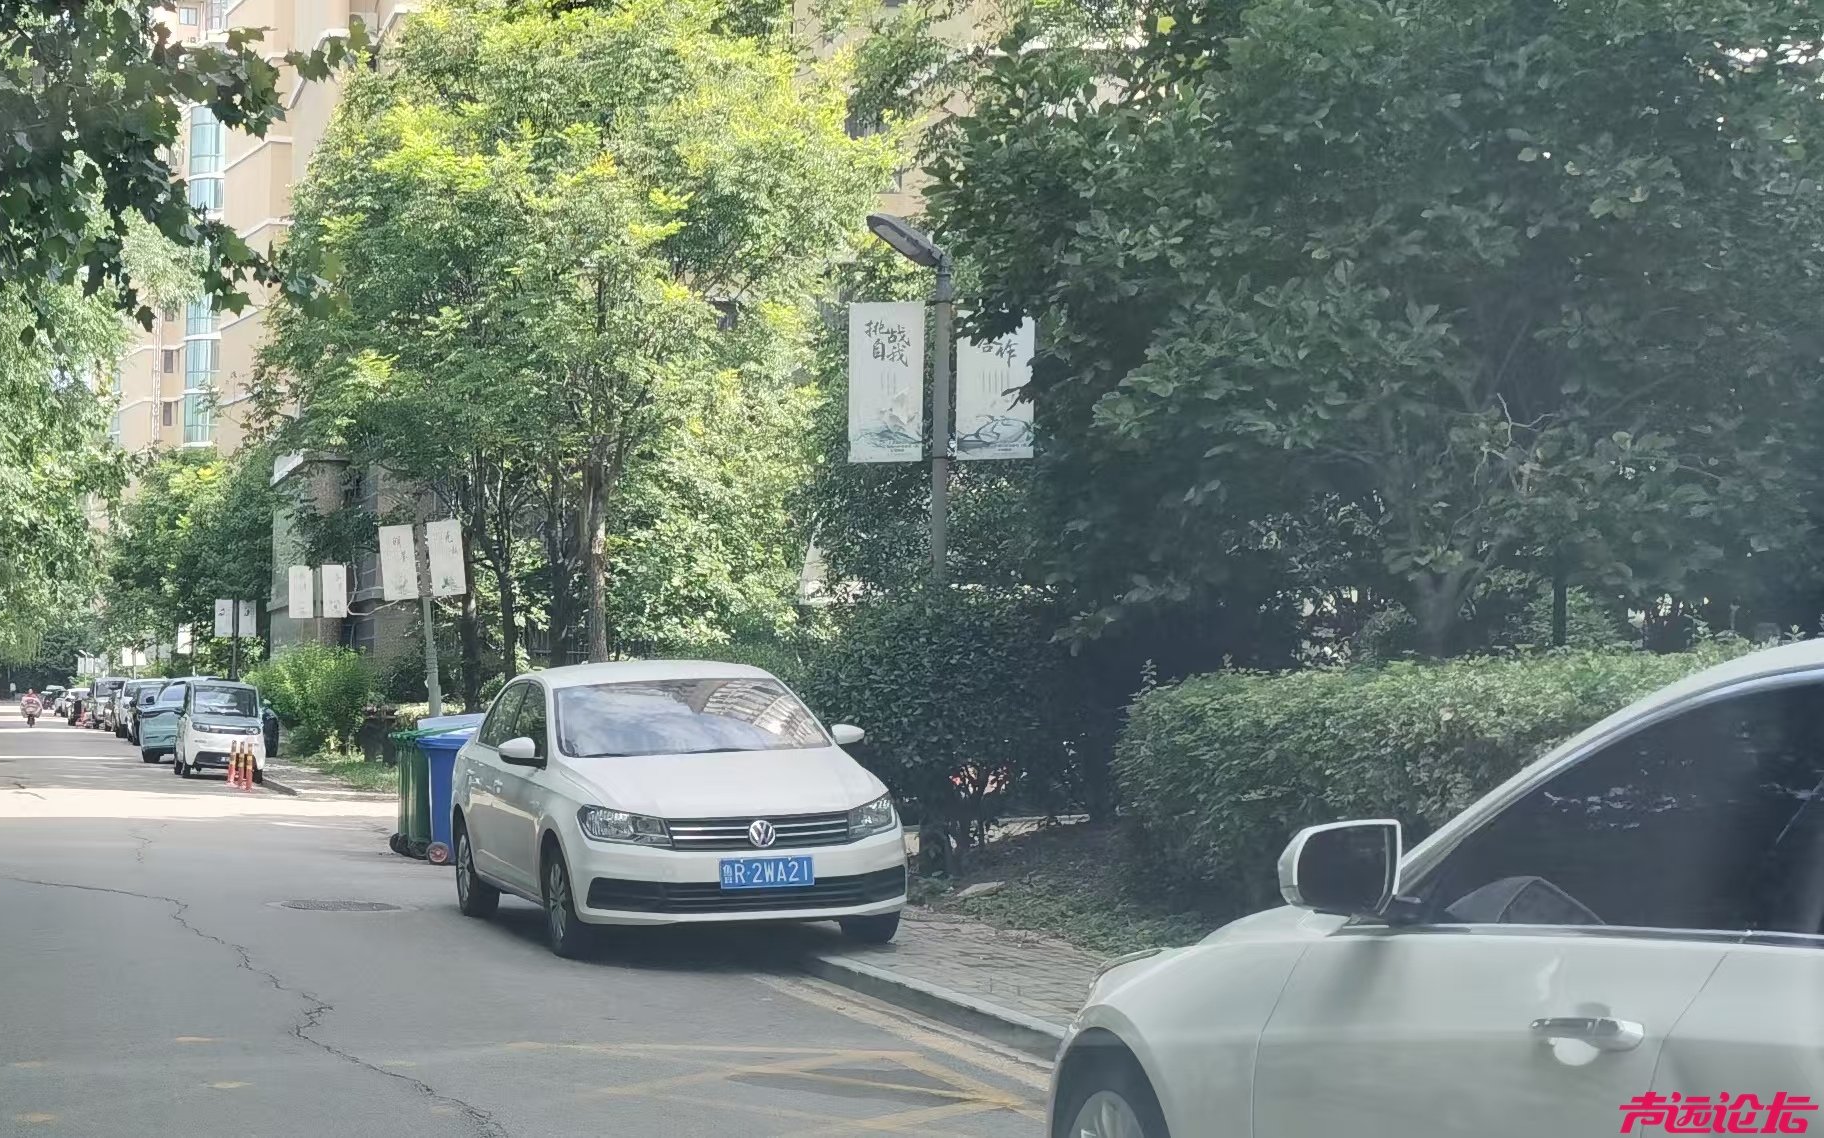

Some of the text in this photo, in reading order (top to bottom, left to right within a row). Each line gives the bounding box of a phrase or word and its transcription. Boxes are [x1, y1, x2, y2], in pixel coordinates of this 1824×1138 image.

[864, 320, 911, 347] 挑战
[872, 338, 909, 367] 自我
[977, 338, 1018, 368] 合作
